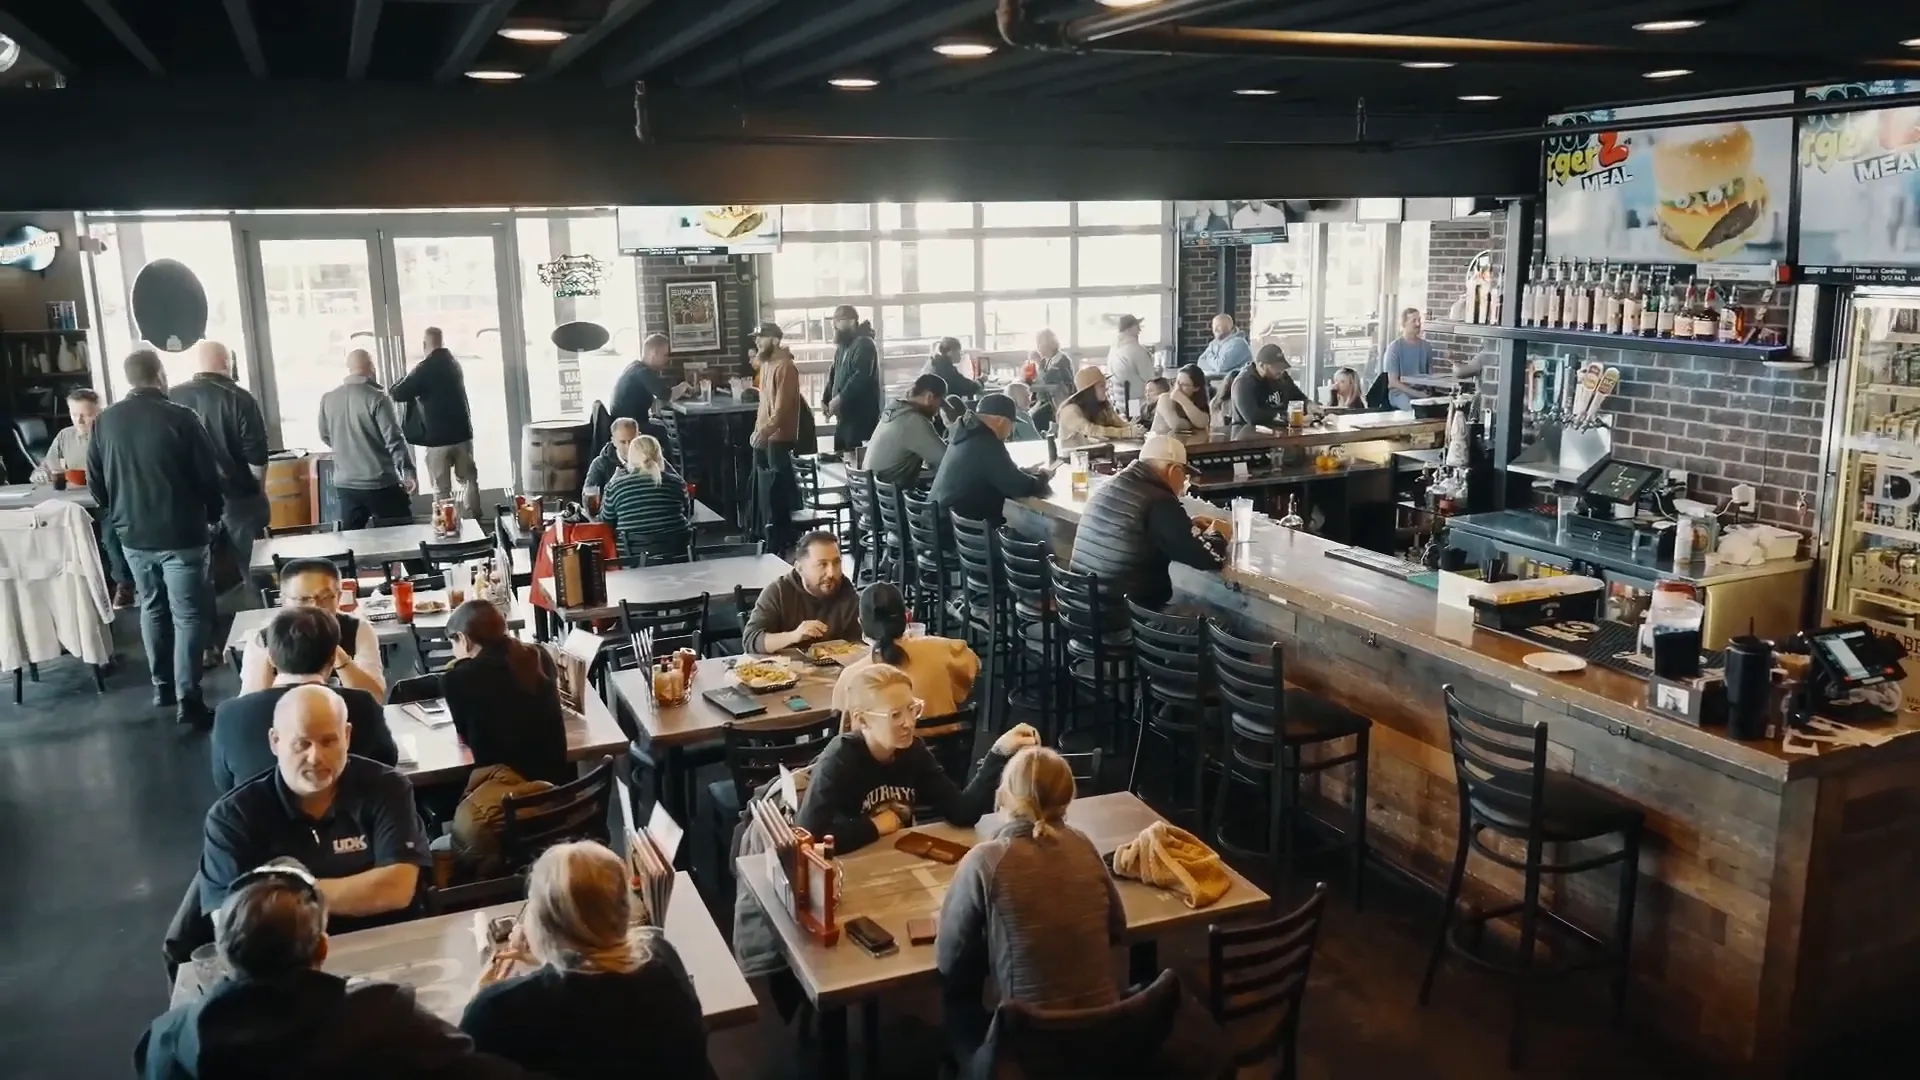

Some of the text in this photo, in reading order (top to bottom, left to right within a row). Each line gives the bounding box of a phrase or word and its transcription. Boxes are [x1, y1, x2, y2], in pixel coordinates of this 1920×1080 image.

[1598, 130, 1629, 167] 2
[1581, 165, 1634, 191] MEAL
[1804, 266, 1827, 274] ESPN
